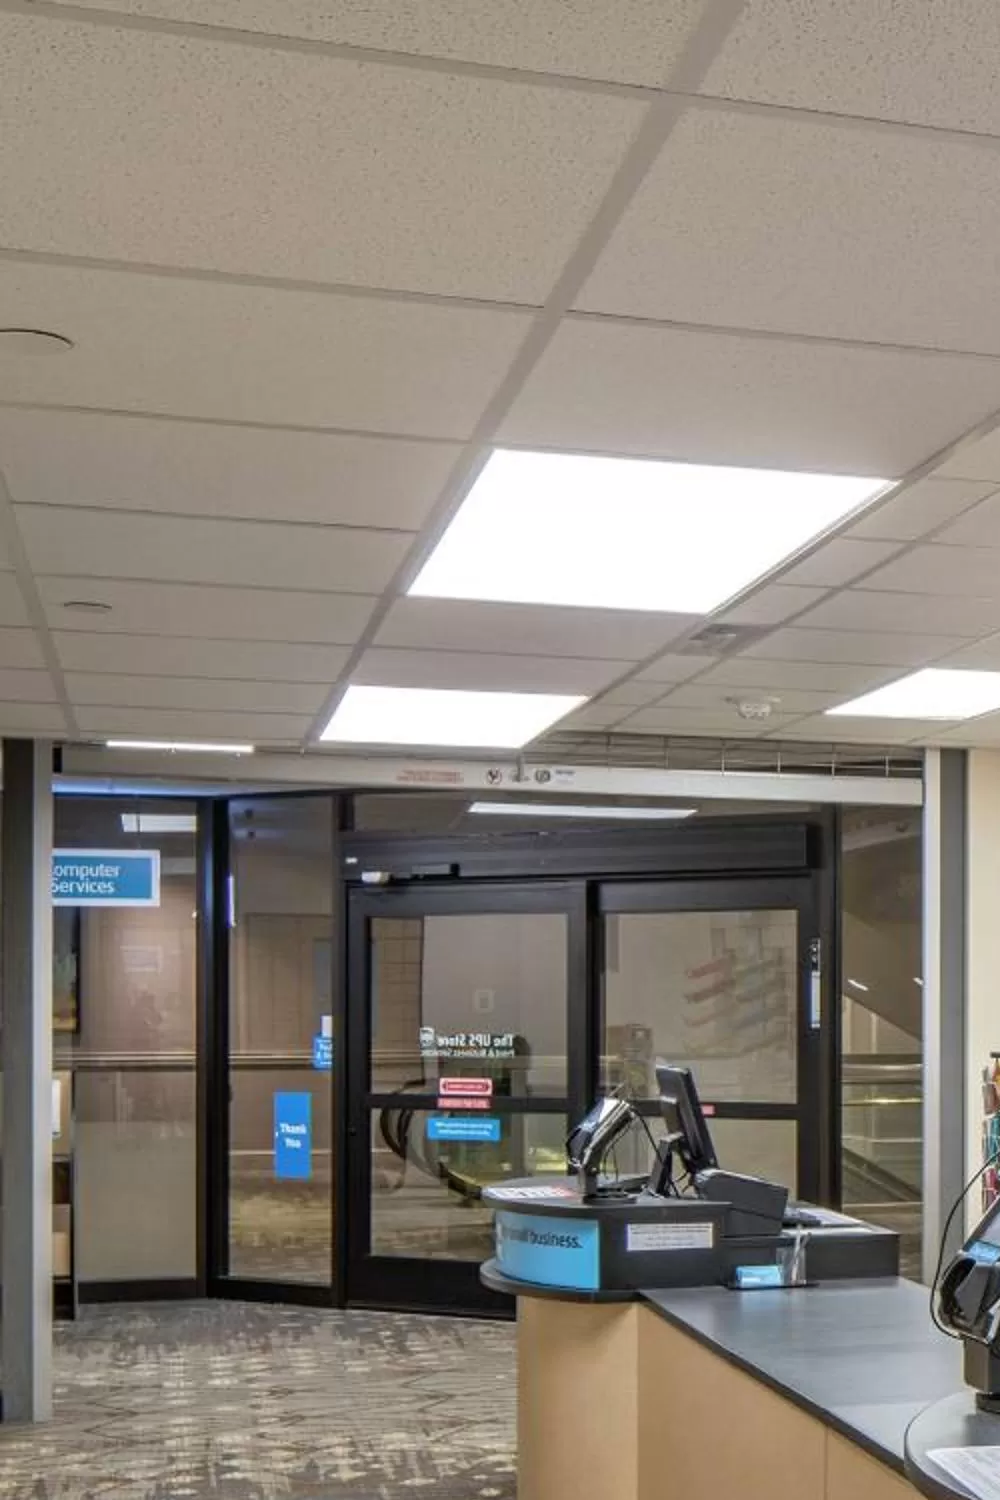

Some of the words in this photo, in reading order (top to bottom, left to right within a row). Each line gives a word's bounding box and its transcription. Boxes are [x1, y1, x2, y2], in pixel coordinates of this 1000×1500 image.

[52, 864, 120, 880] omputer
[51, 878, 115, 893] Services
[280, 1122, 307, 1134] Thank
[527, 1230, 584, 1249] business.
